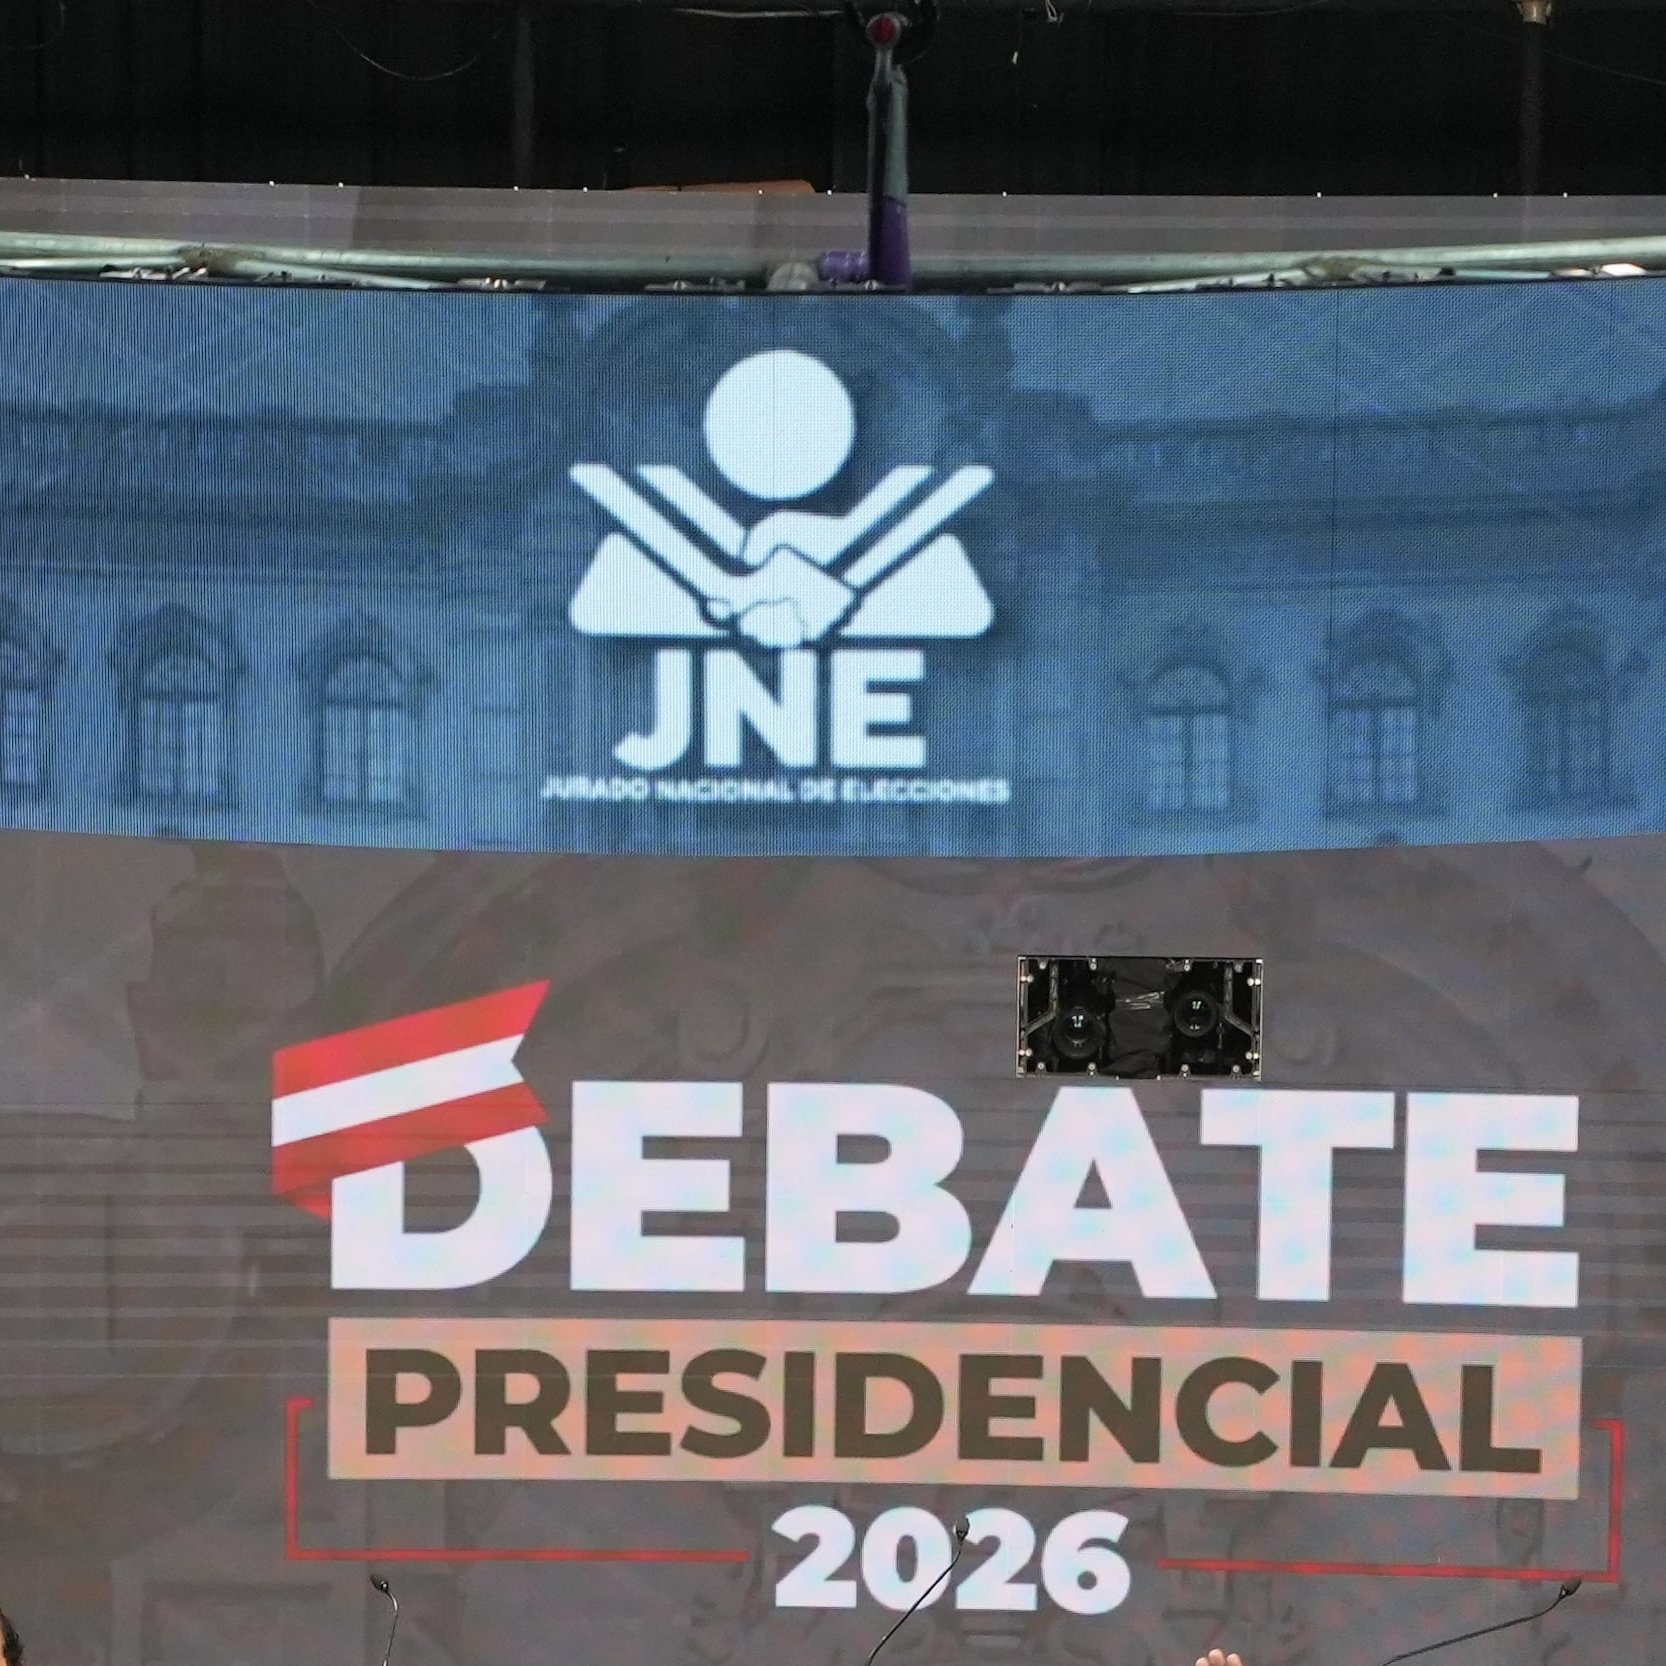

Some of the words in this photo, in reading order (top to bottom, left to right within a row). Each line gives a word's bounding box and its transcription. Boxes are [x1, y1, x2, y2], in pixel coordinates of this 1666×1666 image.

[613, 648, 927, 771] JNE
[540, 774, 650, 803] JURADO
[654, 776, 795, 804] NACIONAL
[799, 777, 835, 804] DE
[841, 776, 1011, 804] ELECCIONES
[331, 1080, 1580, 1310] DEBATE
[363, 1347, 1543, 1476] PRESIDENCIAL
[770, 1504, 1133, 1616] 2026
